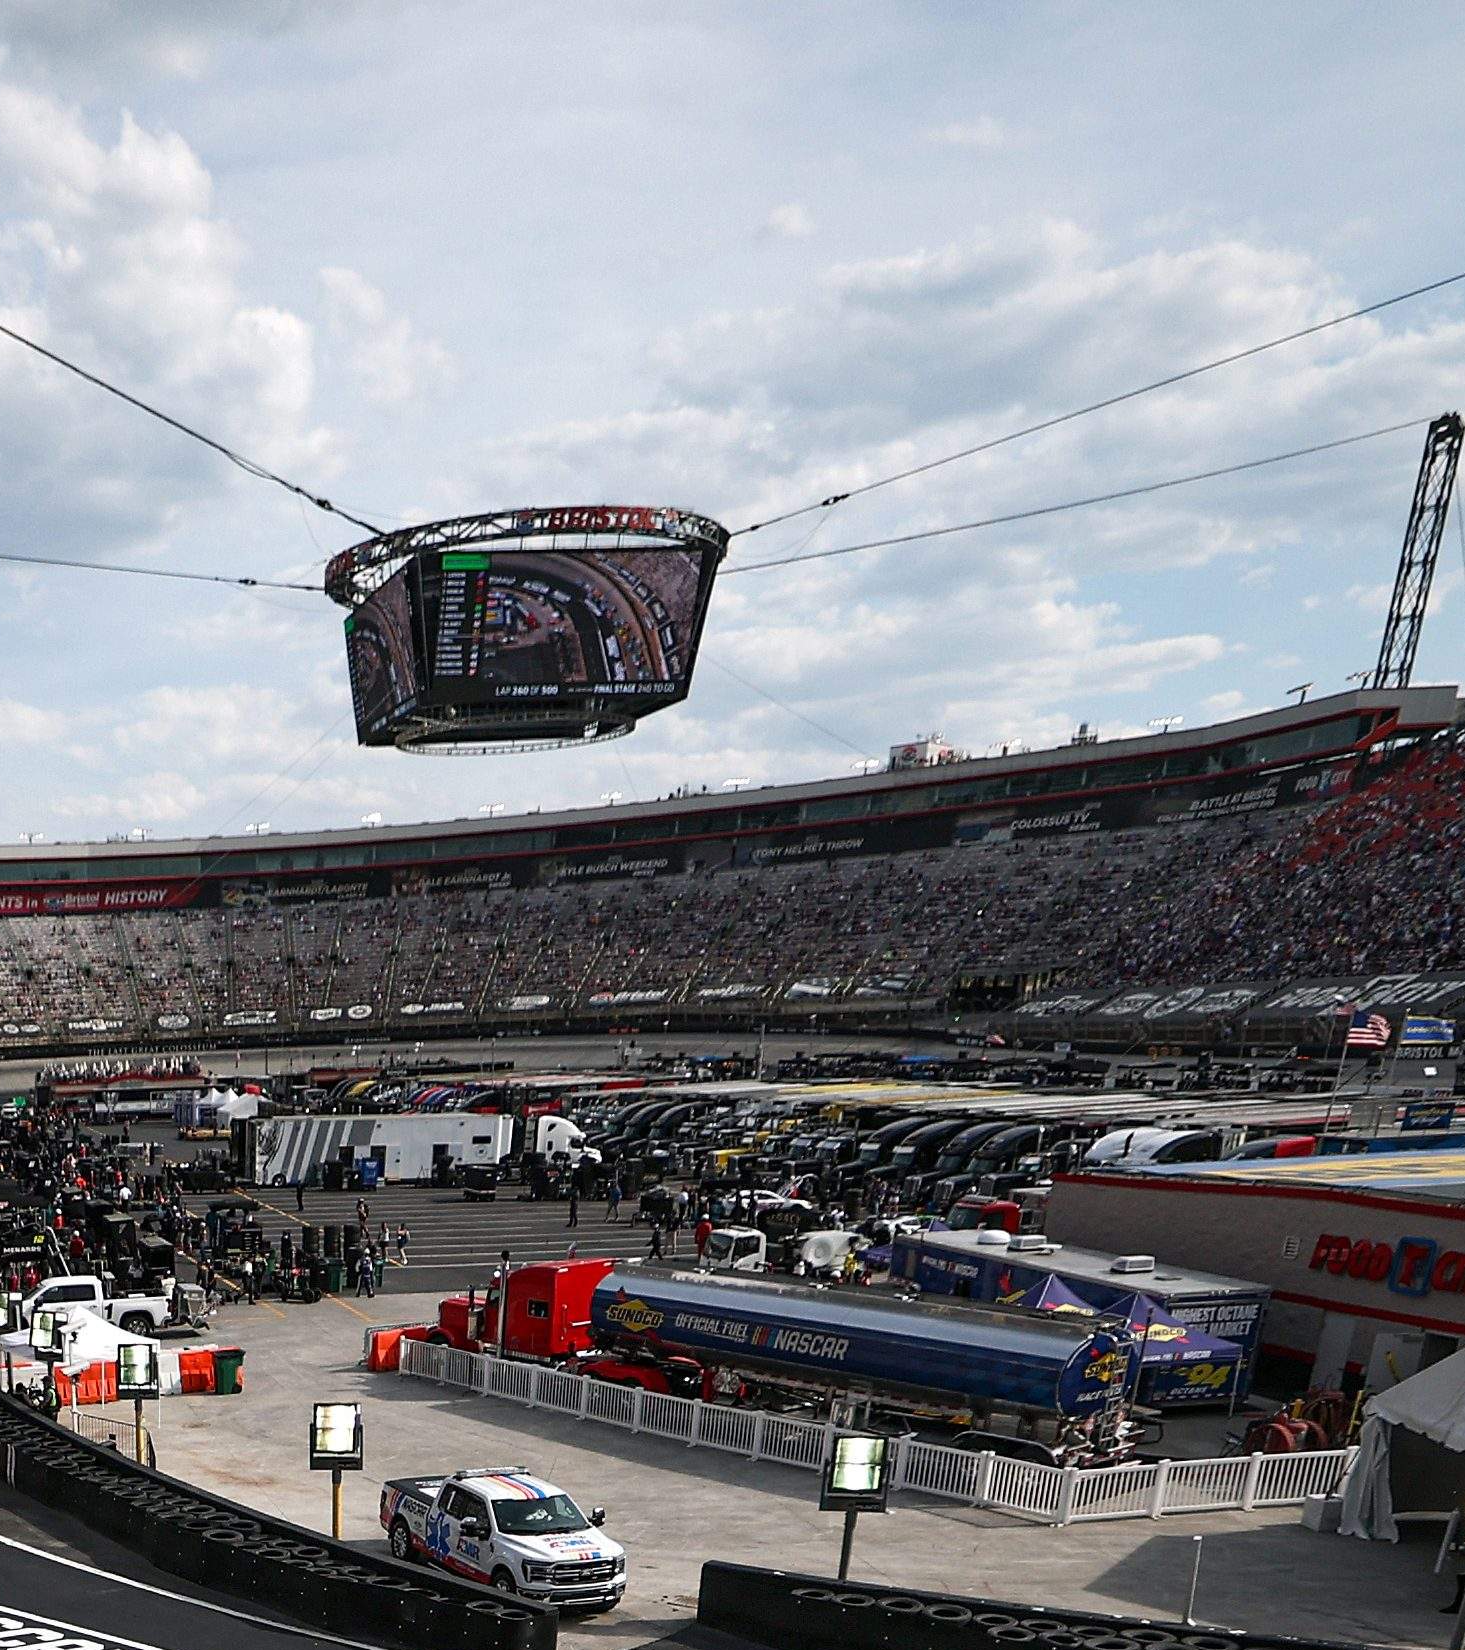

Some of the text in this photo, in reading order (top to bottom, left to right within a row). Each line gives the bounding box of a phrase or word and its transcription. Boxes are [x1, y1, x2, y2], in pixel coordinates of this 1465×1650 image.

[549, 506, 657, 530] BRISTOL
[1010, 814, 1071, 831] COLOSSUS
[827, 837, 865, 854] THROW
[586, 861, 619, 875] BUSCH
[619, 858, 669, 873] WEEKEND
[104, 888, 168, 904] HISTORY
[1395, 1046, 1445, 1059] BRISTOL
[3, 1244, 41, 1253] MENARDS
[1308, 1233, 1394, 1281] FOOD
[606, 1303, 664, 1328] SUNOCO
[1218, 1304, 1259, 1320] OCTANE
[675, 1311, 749, 1340] OFFICIAL FUEL
[1211, 1321, 1252, 1337] MARKET
[774, 1329, 850, 1361] NASCAR
